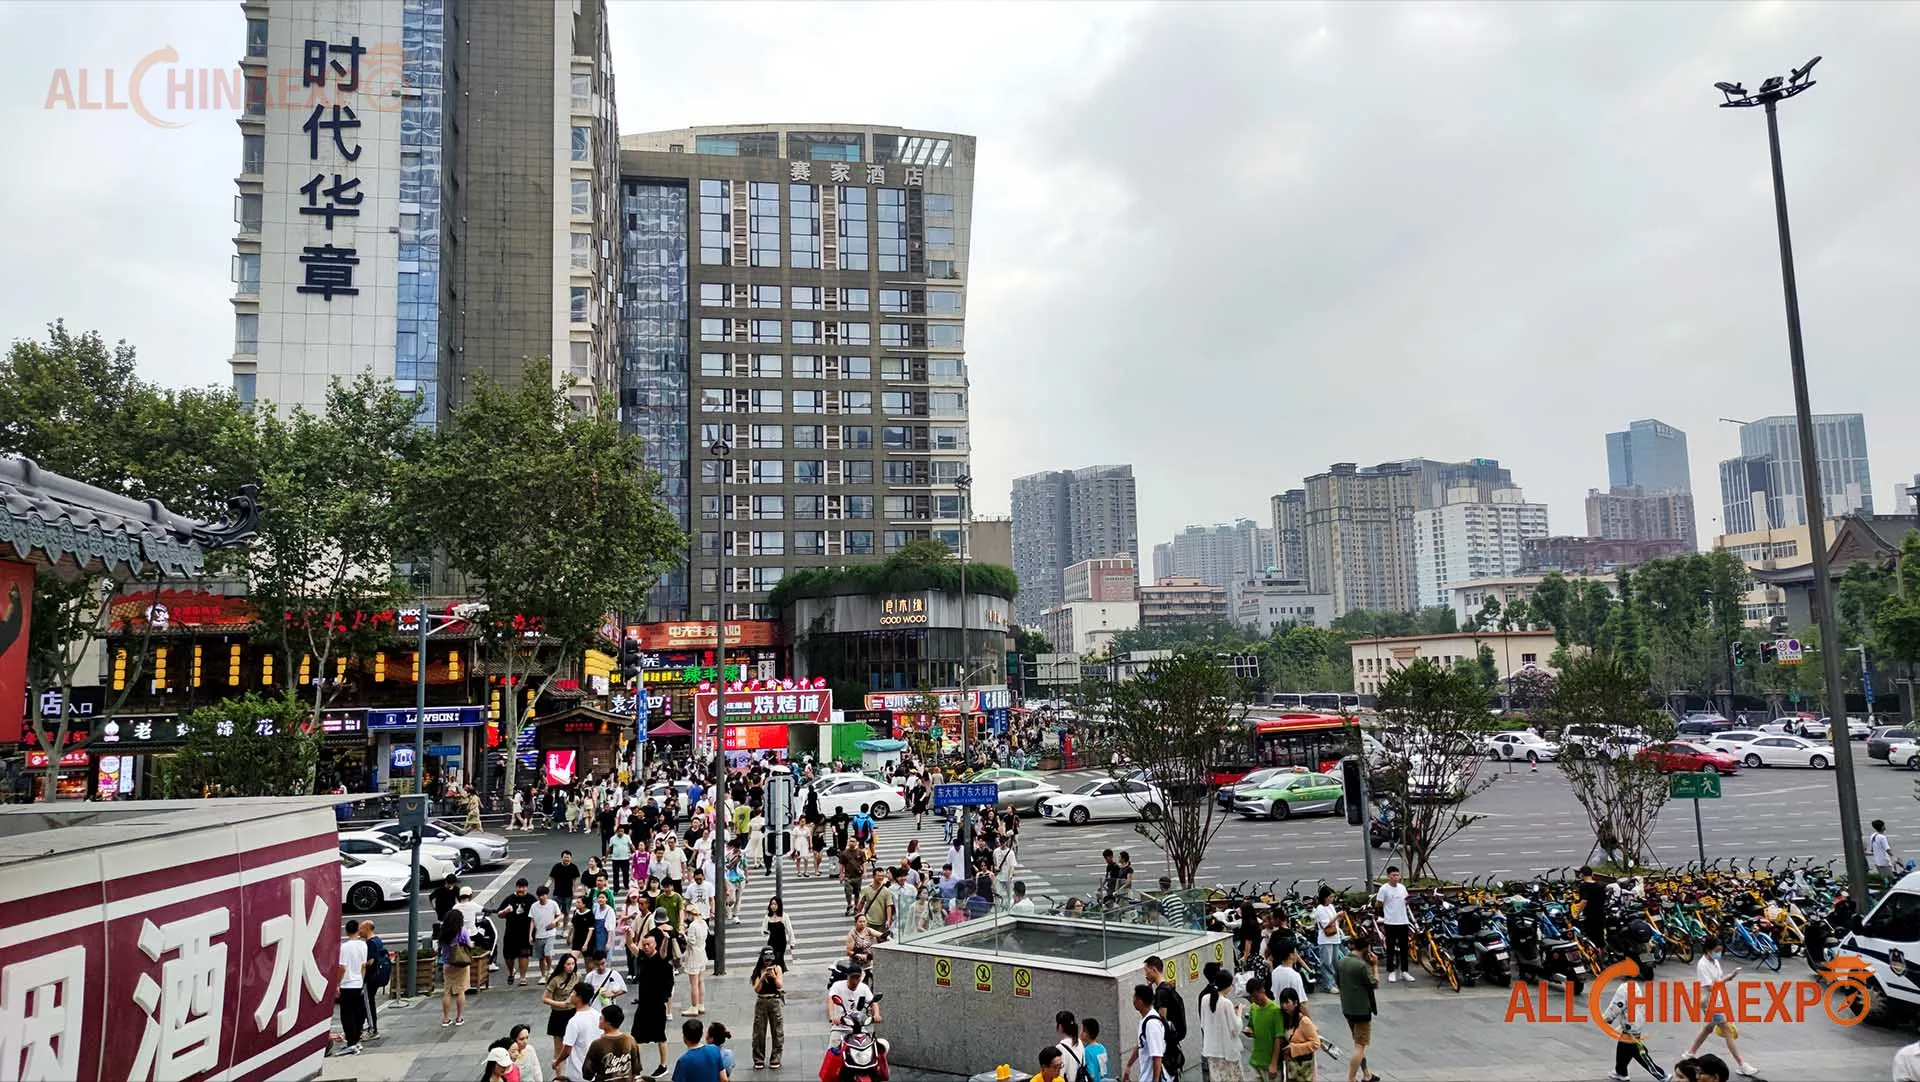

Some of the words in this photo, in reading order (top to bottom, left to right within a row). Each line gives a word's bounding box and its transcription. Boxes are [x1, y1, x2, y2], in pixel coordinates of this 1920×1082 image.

[297, 36, 366, 301] 时代华章
[790, 160, 923, 186] 赛家酒店
[880, 616, 902, 625] GOOD
[904, 615, 927, 624] WOOD
[754, 694, 819, 715] 烧烤城
